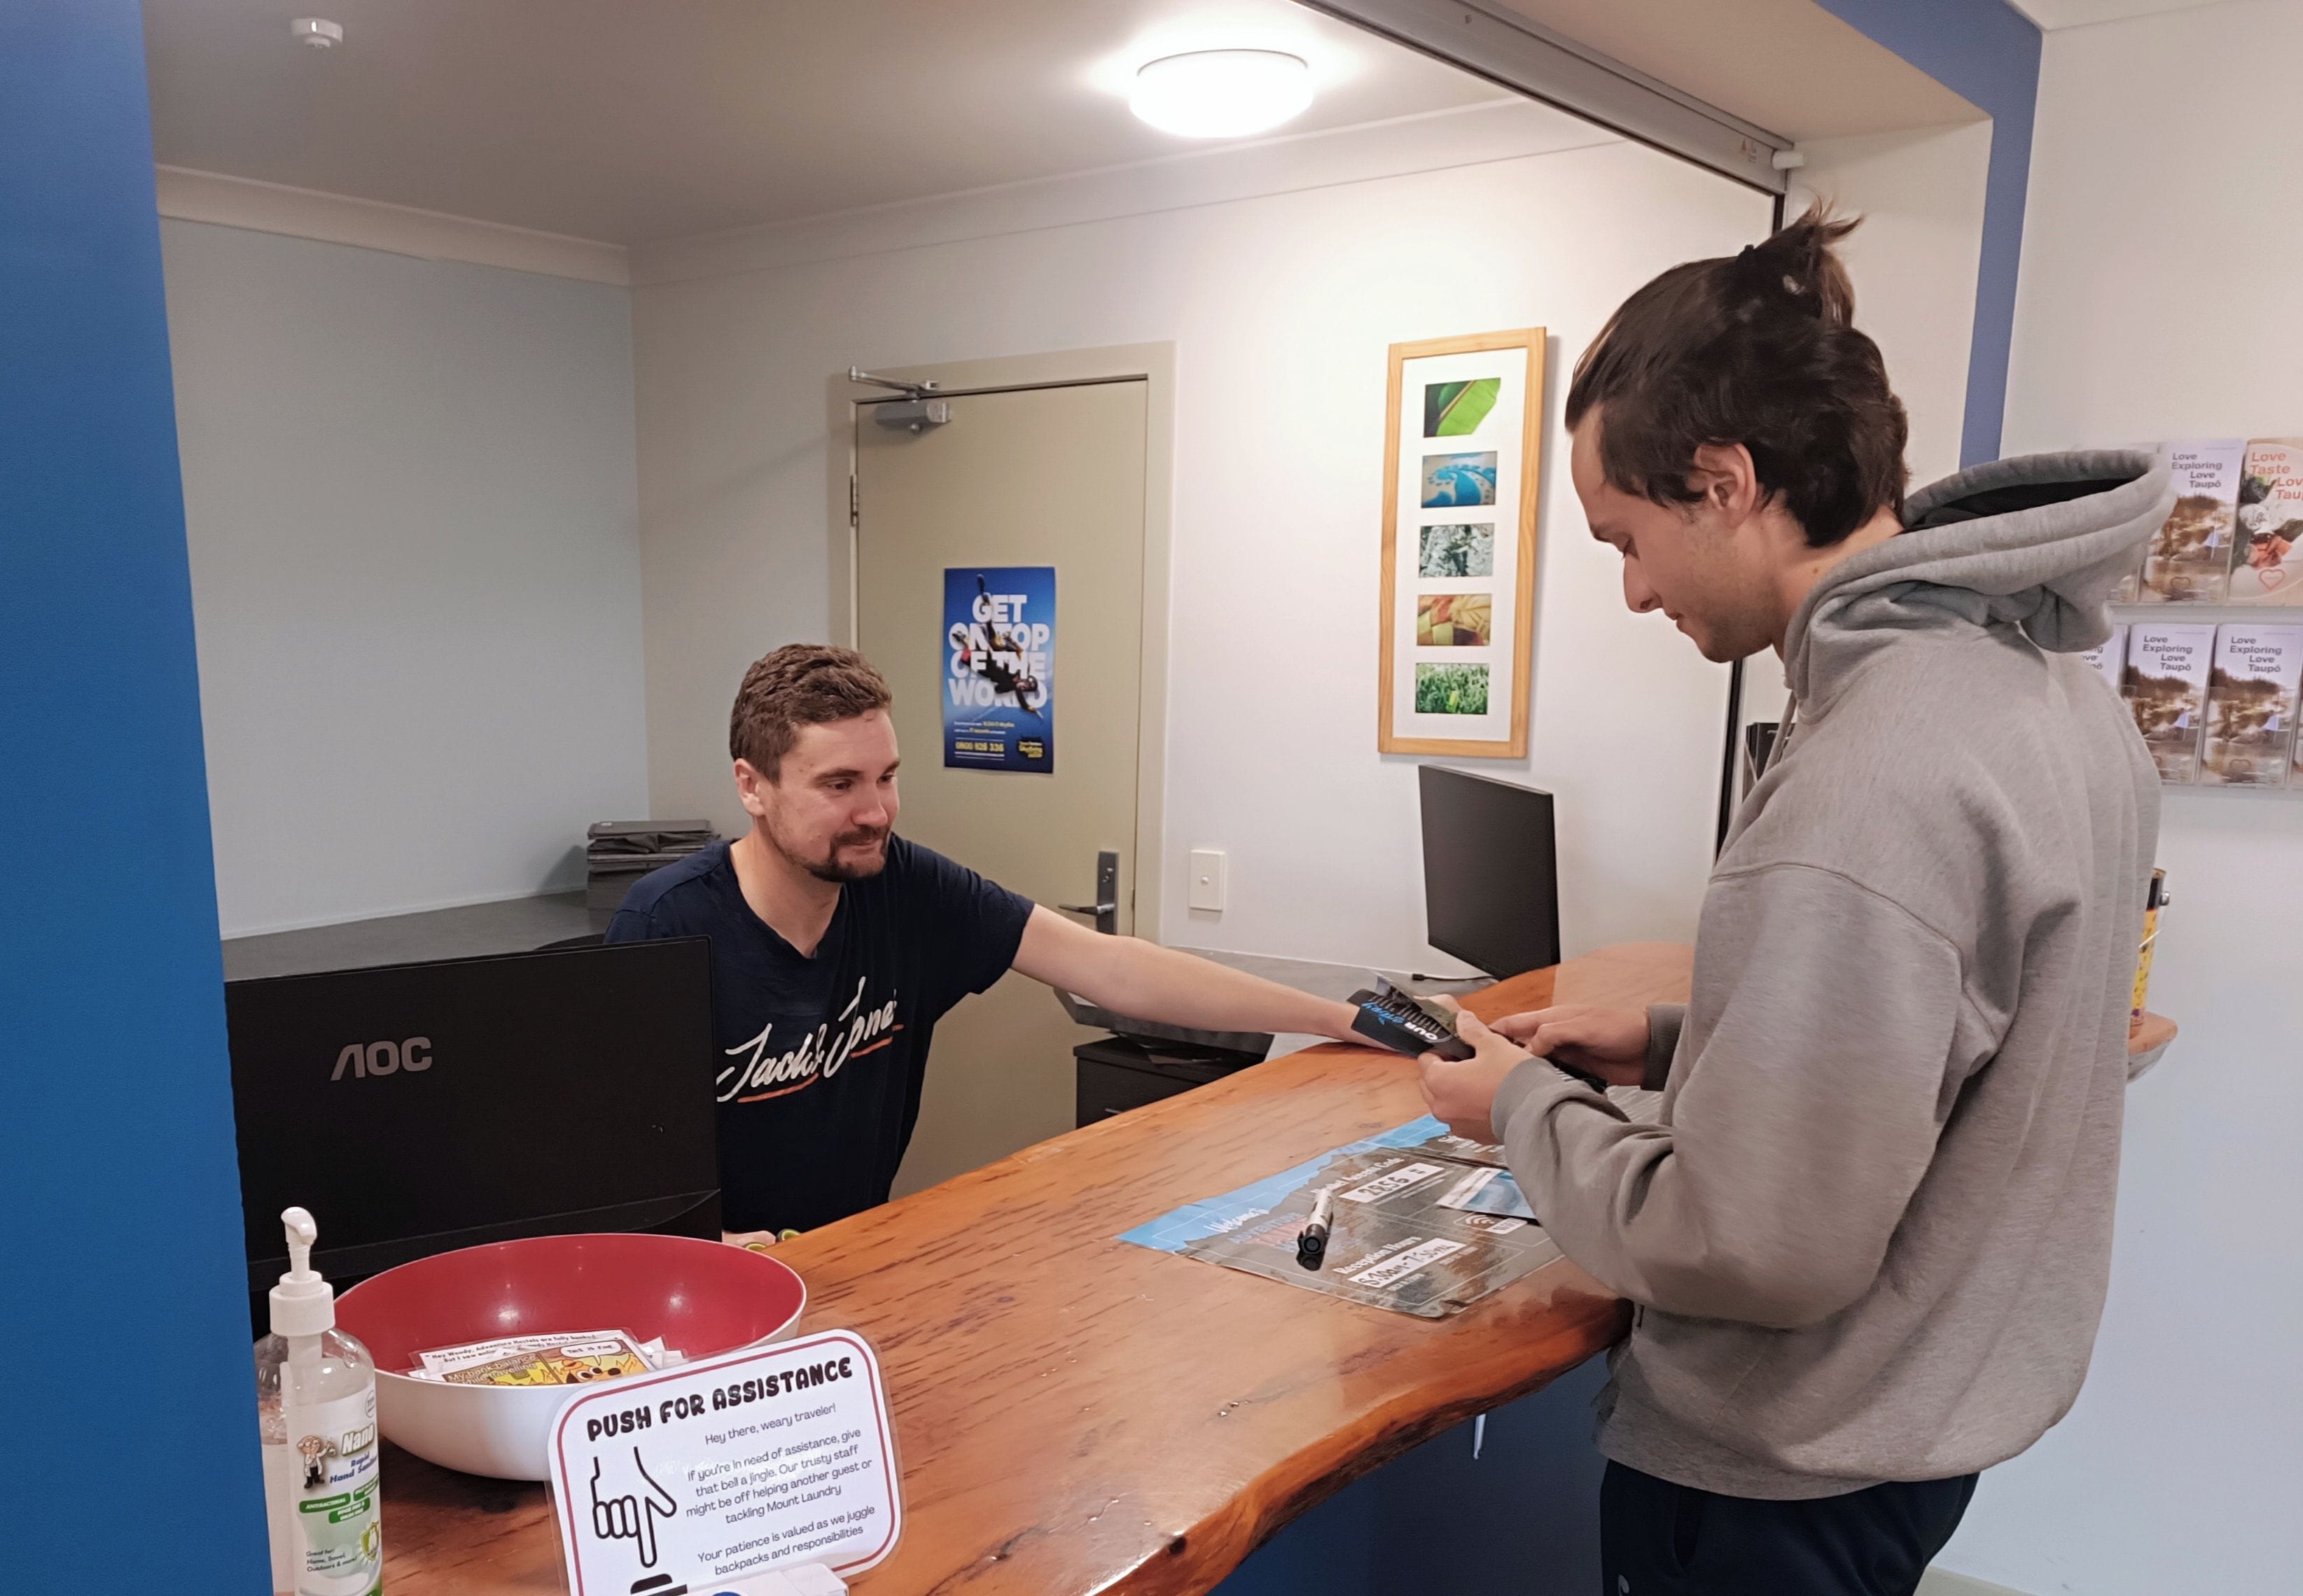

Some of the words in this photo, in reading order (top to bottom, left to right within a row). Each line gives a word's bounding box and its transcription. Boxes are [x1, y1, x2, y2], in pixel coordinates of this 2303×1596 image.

[2172, 462, 2222, 470] Exploring
[2250, 464, 2290, 475] Taste
[2252, 452, 2286, 462] Love
[2276, 477, 2303, 486] Lov
[973, 592, 1027, 622] GET
[2143, 644, 2193, 654] Exploring
[2229, 645, 2282, 655] Exploring
[1405, 1022, 1438, 1040] OUR
[331, 1037, 432, 1081] AOC
[1333, 1249, 1393, 1275] Reception
[447, 1373, 465, 1383] My
[466, 1364, 494, 1377] bank
[494, 1354, 537, 1368] balance
[463, 1373, 489, 1385] hile
[587, 1406, 652, 1441] PUSH
[660, 1394, 705, 1423] FOR
[712, 1357, 852, 1410] ASSISTANCE
[705, 1434, 726, 1445] Hey
[728, 1424, 759, 1439] there,
[760, 1416, 793, 1431] weary
[794, 1403, 836, 1422] traveler!
[341, 1422, 375, 1457] Nano
[688, 1470, 695, 1481] If
[697, 1463, 731, 1481] you're
[732, 1460, 742, 1470] in
[744, 1452, 769, 1466] need
[771, 1448, 782, 1460] of
[785, 1434, 840, 1456] assistance,
[842, 1429, 861, 1443] give
[330, 1469, 354, 1483] Hand
[695, 1483, 719, 1497] that
[721, 1477, 739, 1490] bell
[749, 1467, 777, 1485] jingle.
[779, 1462, 799, 1474] Our
[800, 1453, 832, 1469] trusty
[834, 1444, 859, 1460] staff
[686, 1501, 716, 1518] might
[718, 1497, 732, 1508] be
[735, 1491, 751, 1504] off
[753, 1482, 788, 1499] helping
[791, 1471, 830, 1489] another
[832, 1464, 860, 1480] guest
[861, 1460, 872, 1469] or
[725, 1506, 765, 1524] tackling
[767, 1496, 800, 1513] Mount
[801, 1485, 842, 1503] Laundry
[697, 1549, 723, 1562] Your
[725, 1536, 770, 1556] patience
[772, 1532, 780, 1541] is
[781, 1520, 814, 1539] valued
[816, 1520, 828, 1529] as
[830, 1516, 845, 1525] we
[847, 1506, 875, 1523] juggle
[715, 1553, 770, 1575] backpacks
[772, 1545, 791, 1559] and
[792, 1525, 863, 1553] responsibilities
